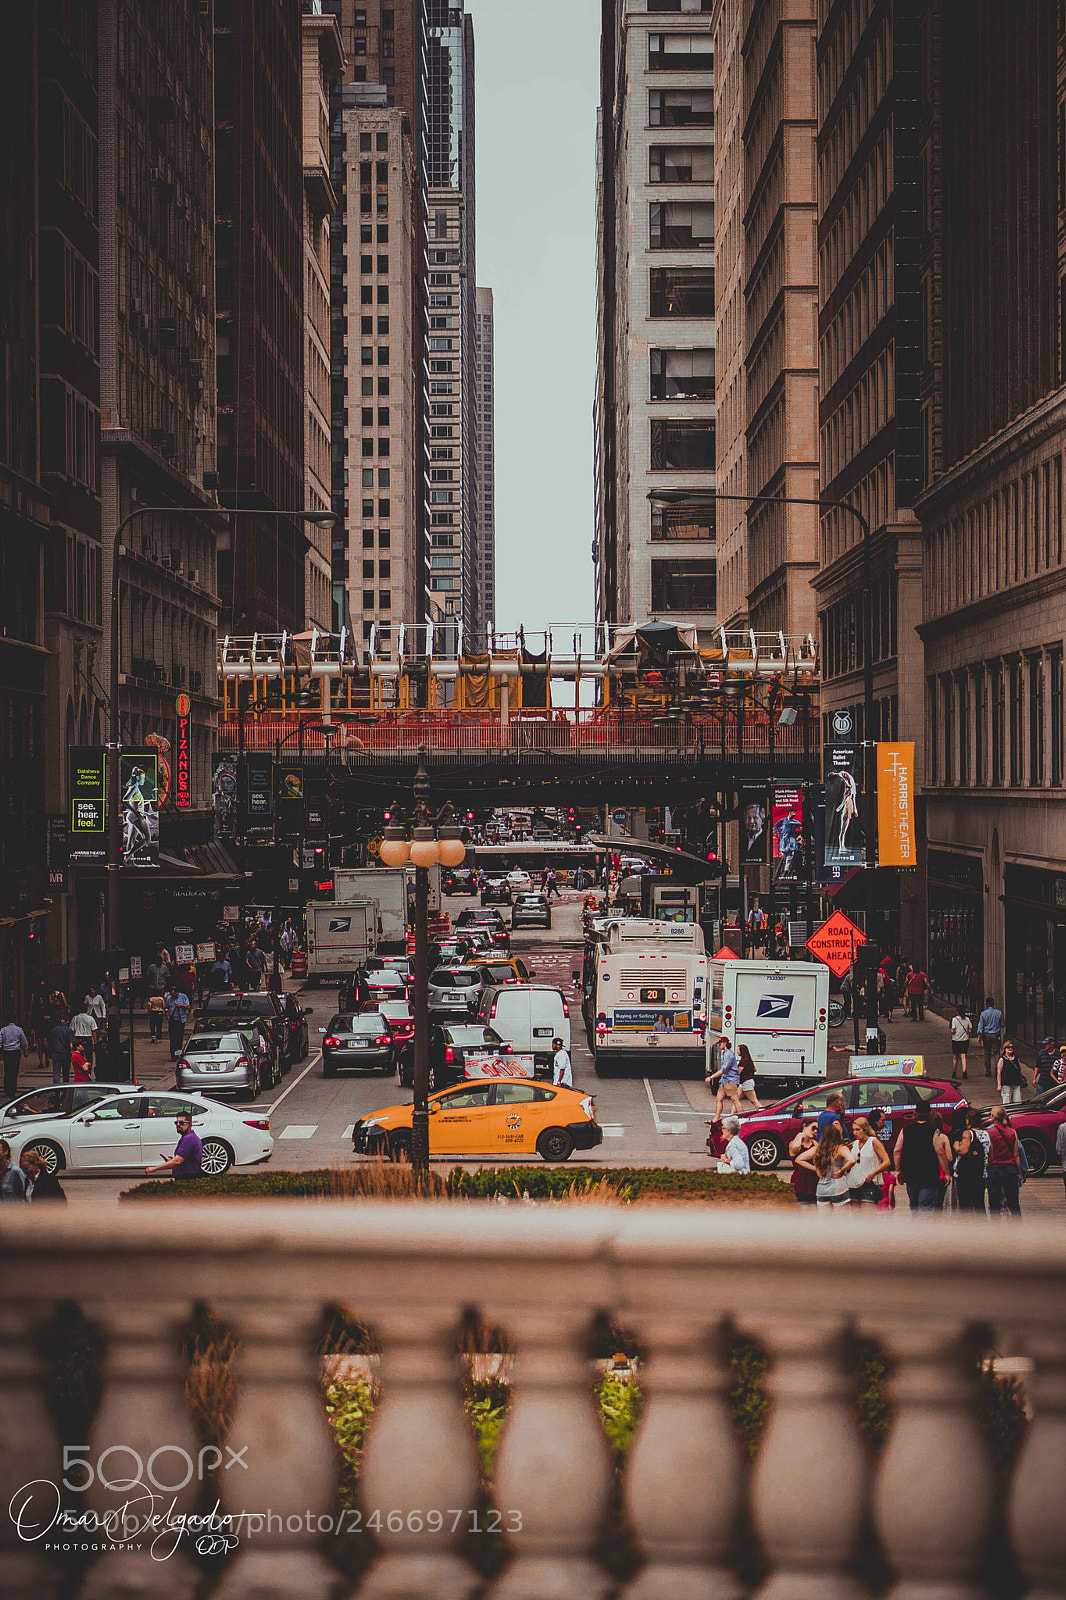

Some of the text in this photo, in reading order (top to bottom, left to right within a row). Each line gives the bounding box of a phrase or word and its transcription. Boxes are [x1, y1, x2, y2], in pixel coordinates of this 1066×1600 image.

[178, 718, 189, 791] PIZANOS
[898, 767, 908, 810] HARRIS
[77, 810, 99, 819] hear.
[77, 819, 96, 827] feel.
[899, 811, 910, 858] THEATER
[828, 928, 849, 936] ROAD
[811, 939, 867, 949] CONSTRUCION
[827, 952, 852, 960] AHEAD
[647, 990, 658, 999] 20
